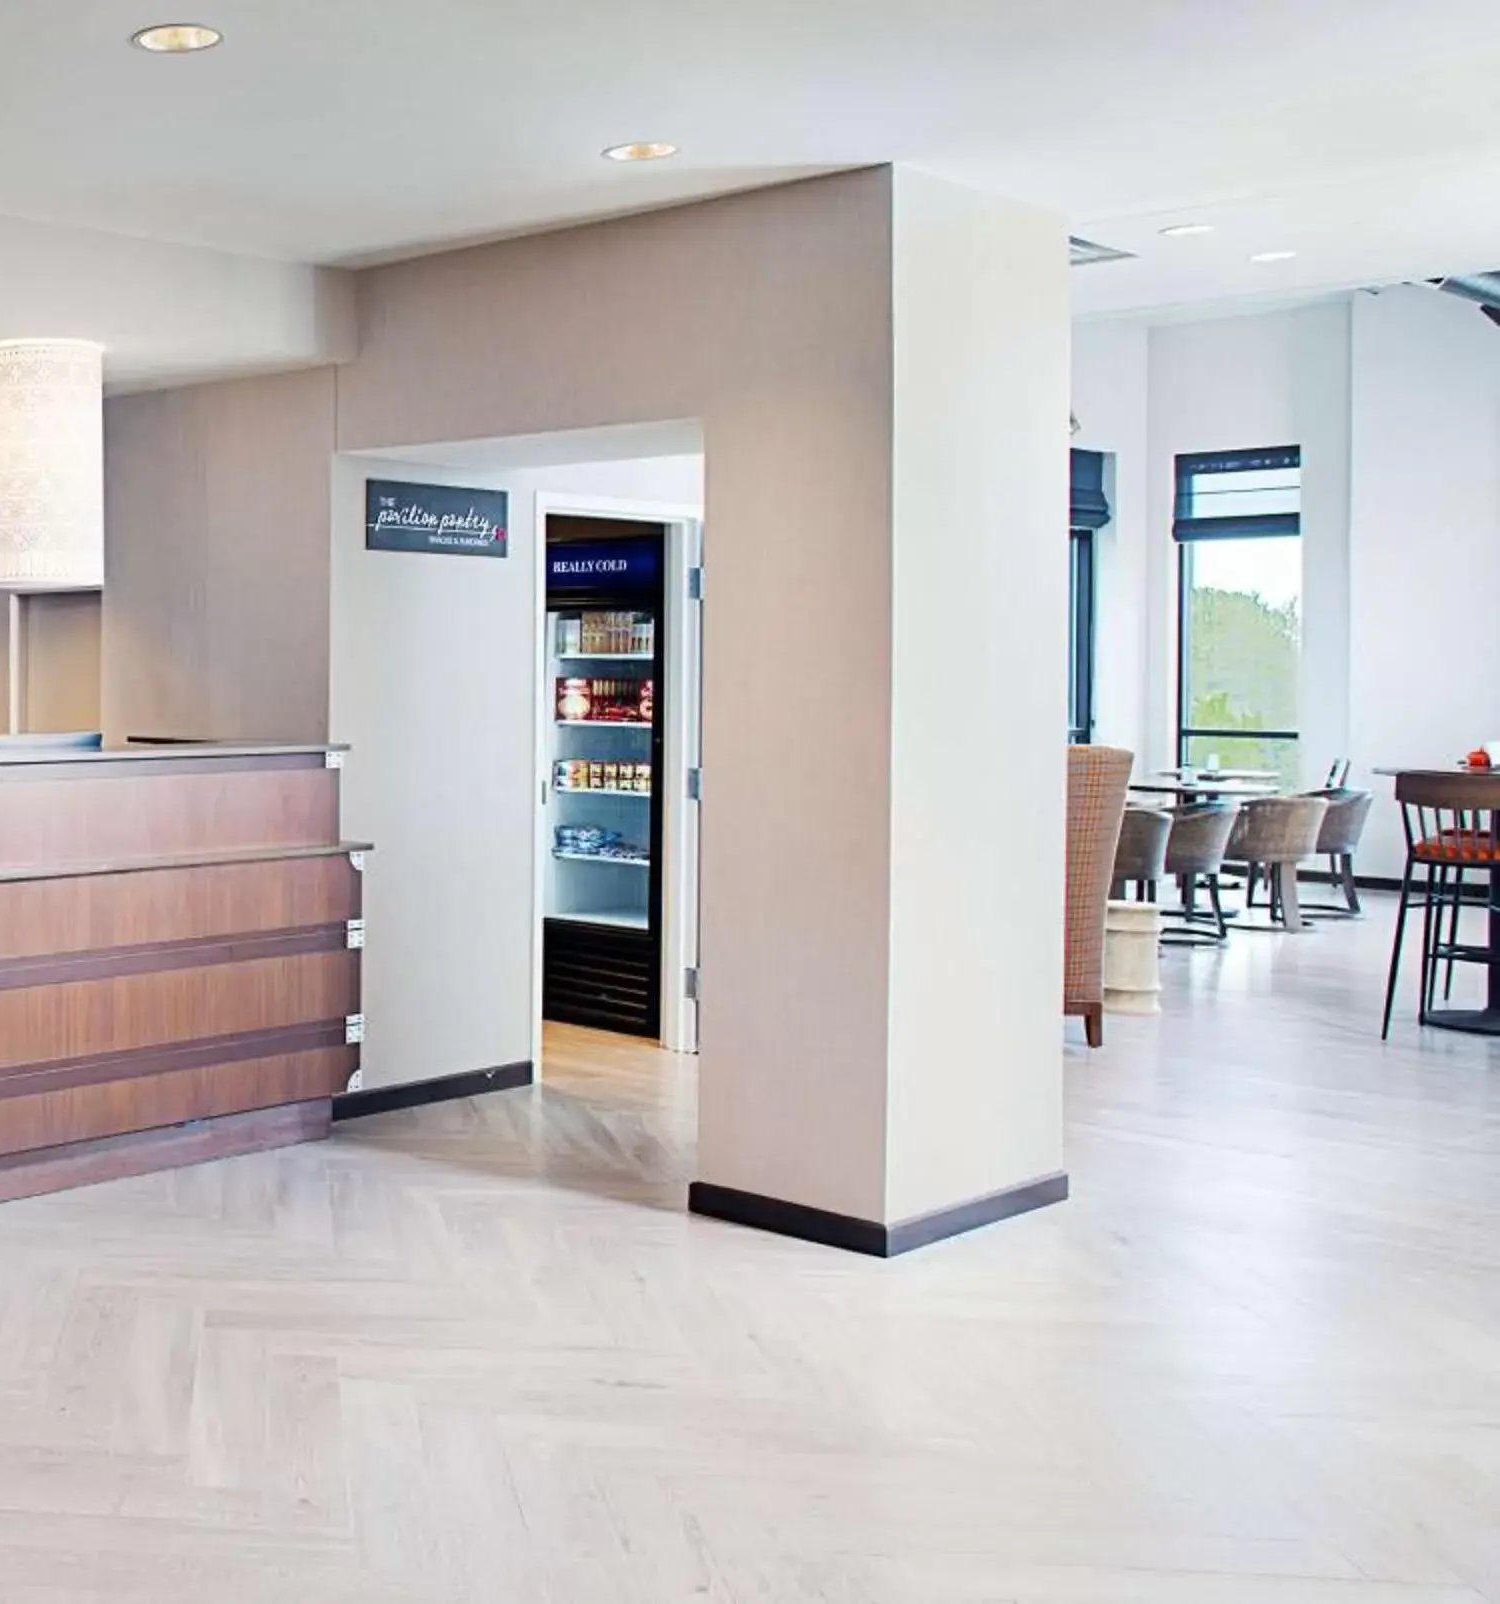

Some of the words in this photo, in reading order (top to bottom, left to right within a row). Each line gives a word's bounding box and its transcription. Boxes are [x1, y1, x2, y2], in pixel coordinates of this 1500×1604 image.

[375, 504, 438, 532] pavilion
[437, 507, 490, 537] pantry
[553, 560, 594, 573] REALLY
[595, 559, 628, 572] COLD
